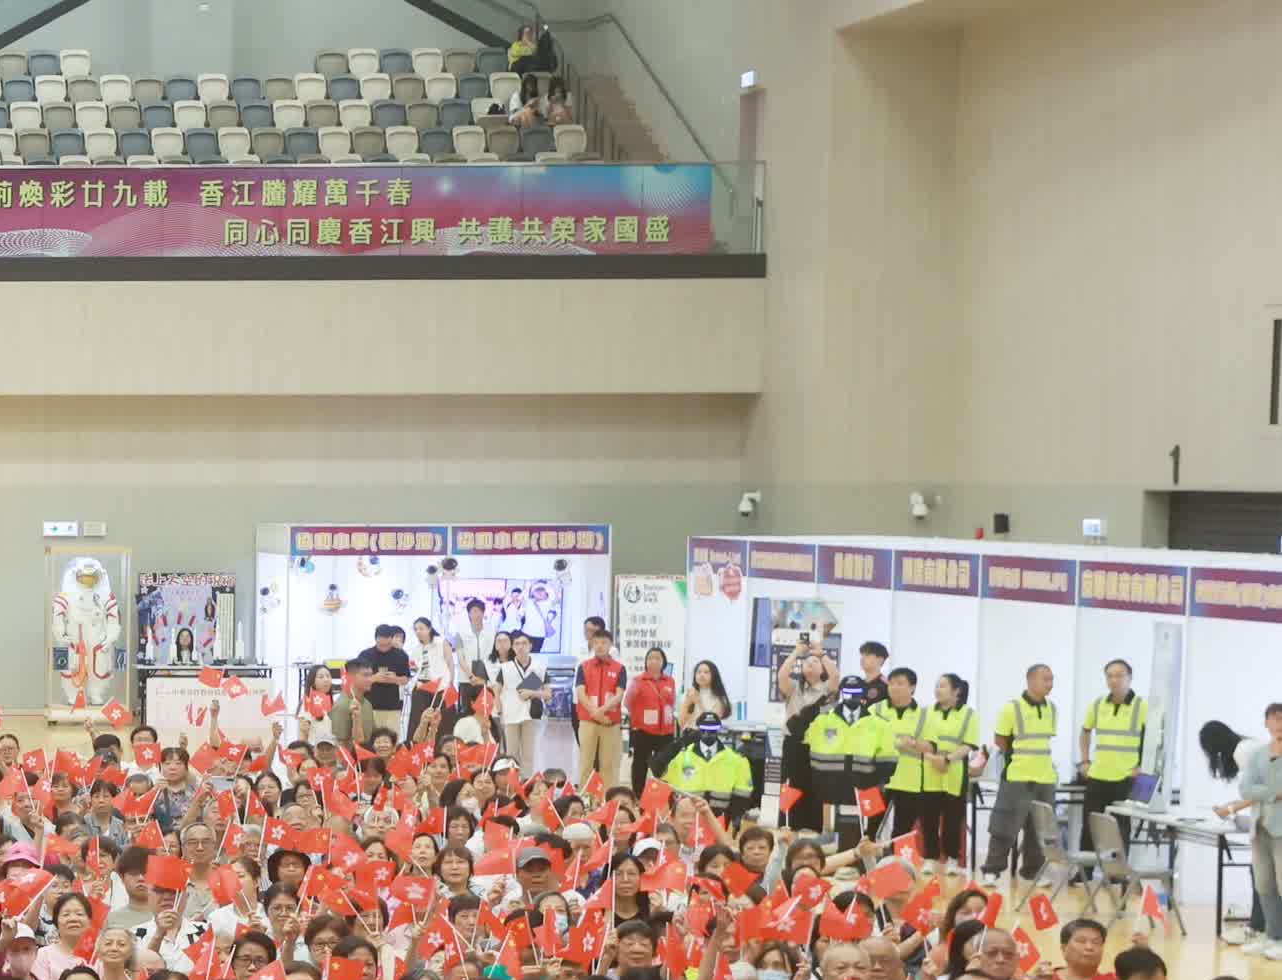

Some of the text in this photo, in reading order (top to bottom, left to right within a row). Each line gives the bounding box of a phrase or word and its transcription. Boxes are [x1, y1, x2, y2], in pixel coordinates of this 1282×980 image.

[199, 179, 413, 208] 香江騰耀萬千春
[224, 215, 671, 247] 同心同慶香江興 共護共榮家國盛
[1169, 445, 1180, 485] 1
